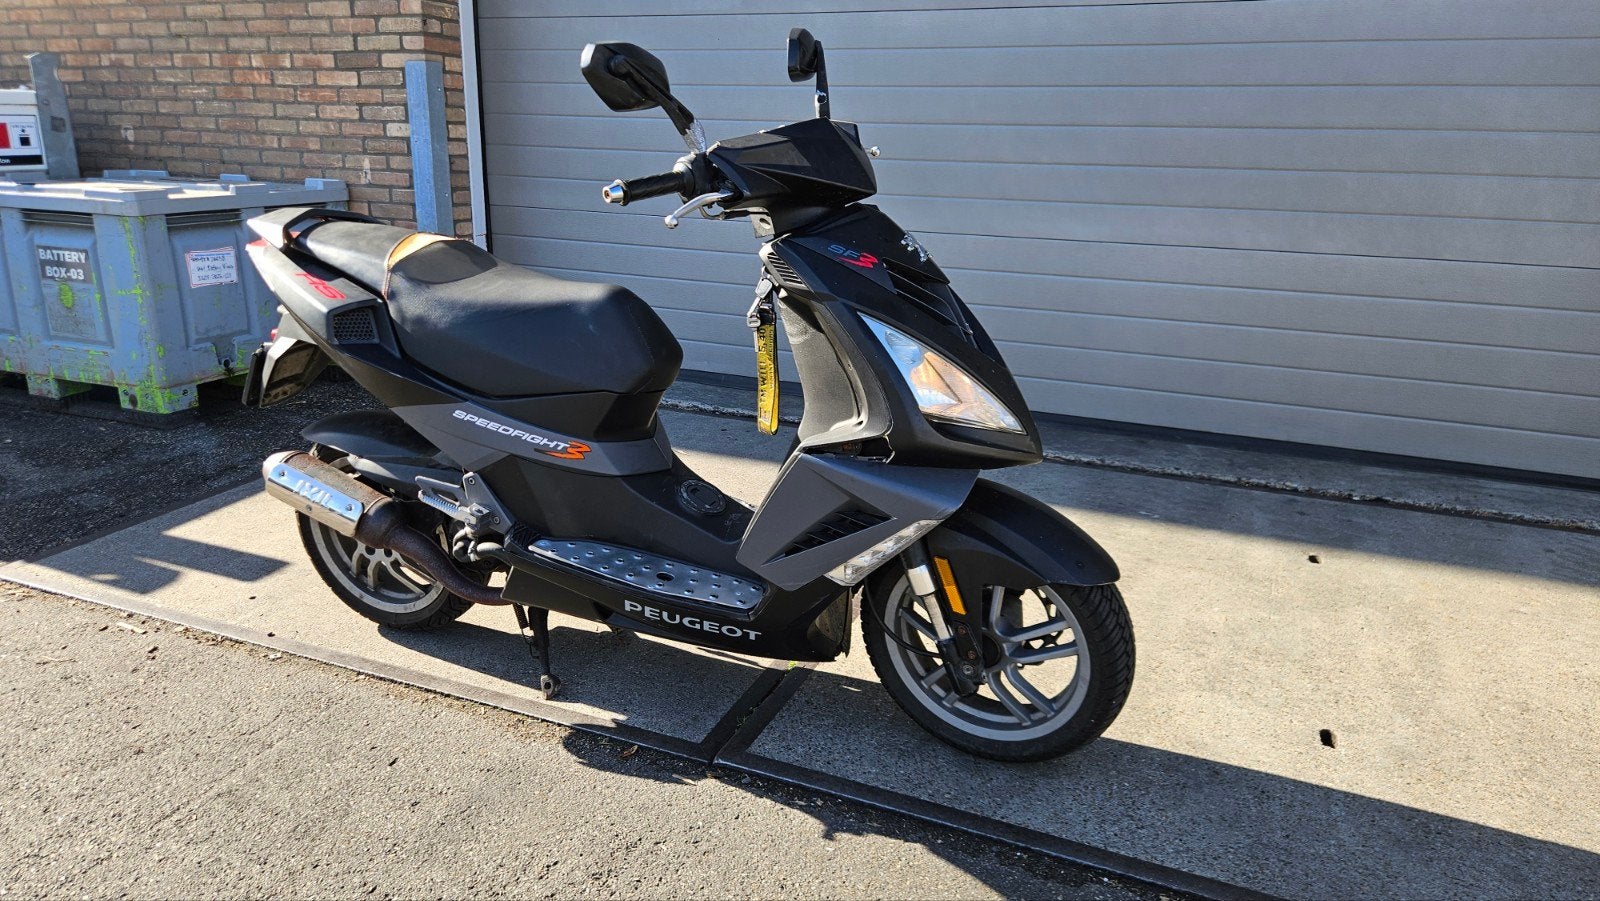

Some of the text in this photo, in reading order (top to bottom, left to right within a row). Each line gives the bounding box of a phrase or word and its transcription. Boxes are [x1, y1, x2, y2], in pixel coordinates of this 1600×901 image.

[38, 248, 86, 264] BATTERY
[828, 244, 860, 259] SF
[45, 265, 85, 280] BOX-03
[452, 409, 571, 450] SPEEDFIGHT
[624, 599, 762, 641] PEUGEOT
